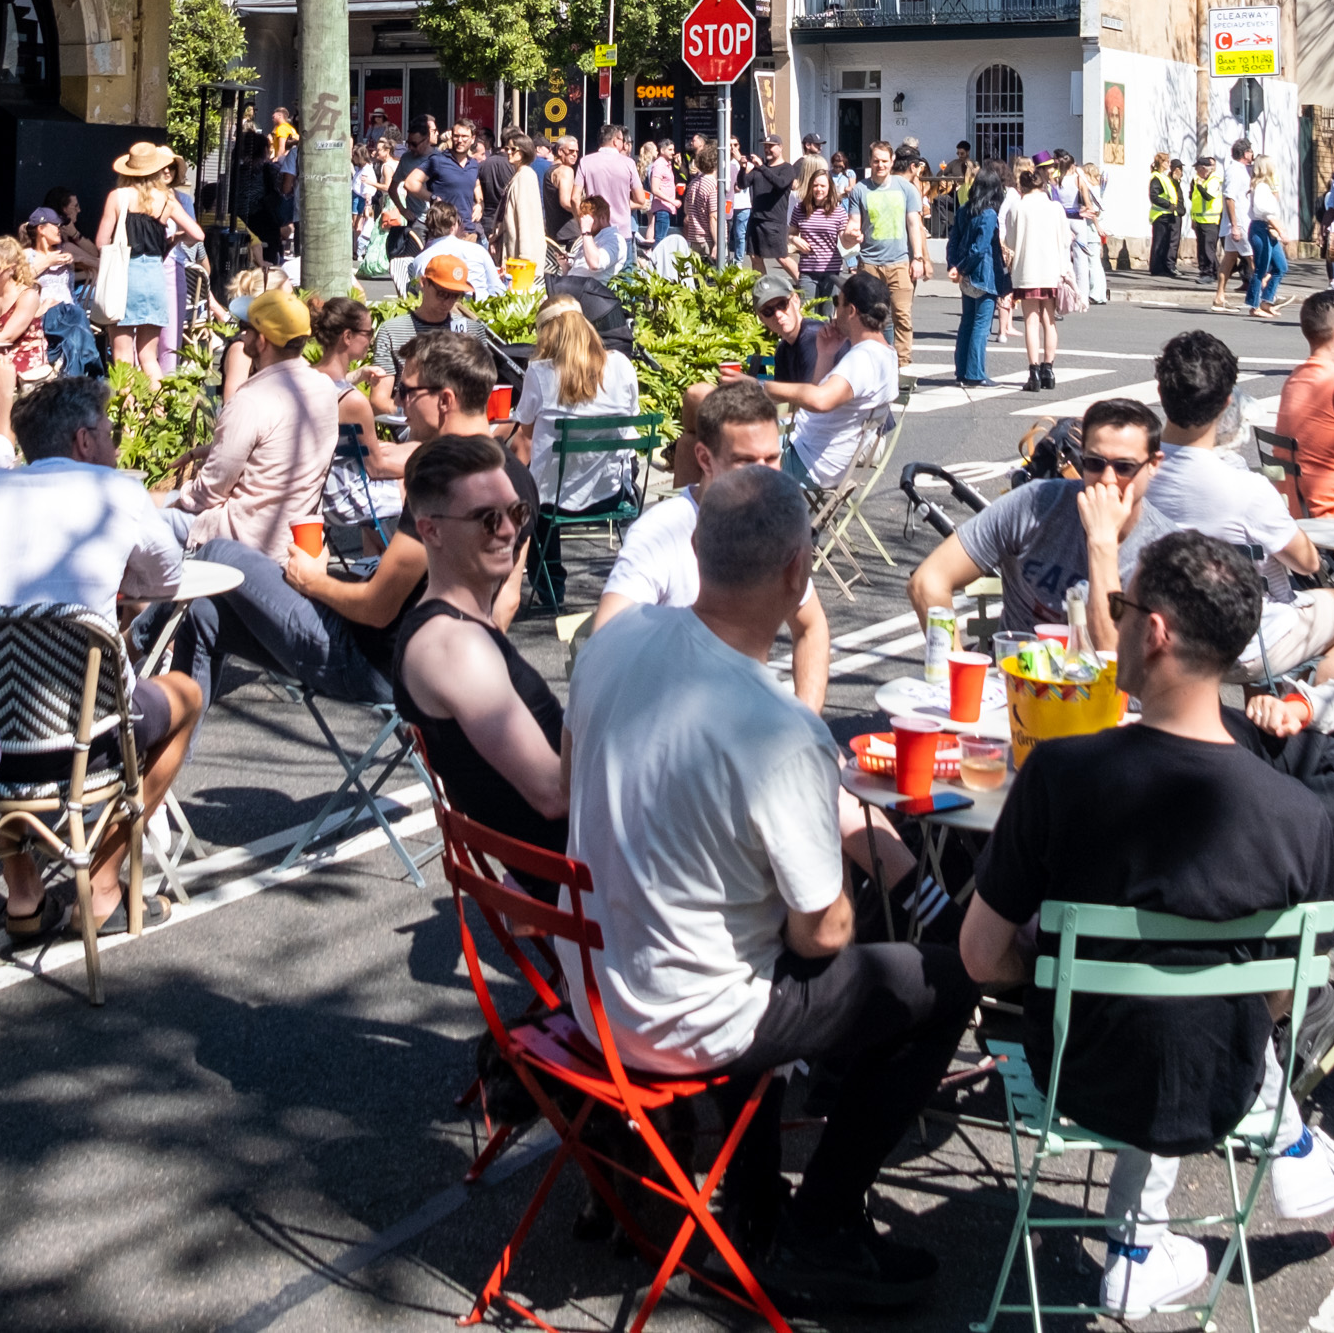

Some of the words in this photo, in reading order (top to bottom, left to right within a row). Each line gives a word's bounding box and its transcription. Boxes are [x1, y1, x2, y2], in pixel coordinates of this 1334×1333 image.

[1216, 10, 1269, 21] CLEARWAY
[1213, 21, 1244, 29] SPECIAL
[1246, 20, 1275, 28] EVENTS
[688, 23, 751, 57] STOP
[1217, 55, 1236, 65] 8AM
[1241, 64, 1250, 73] 15
